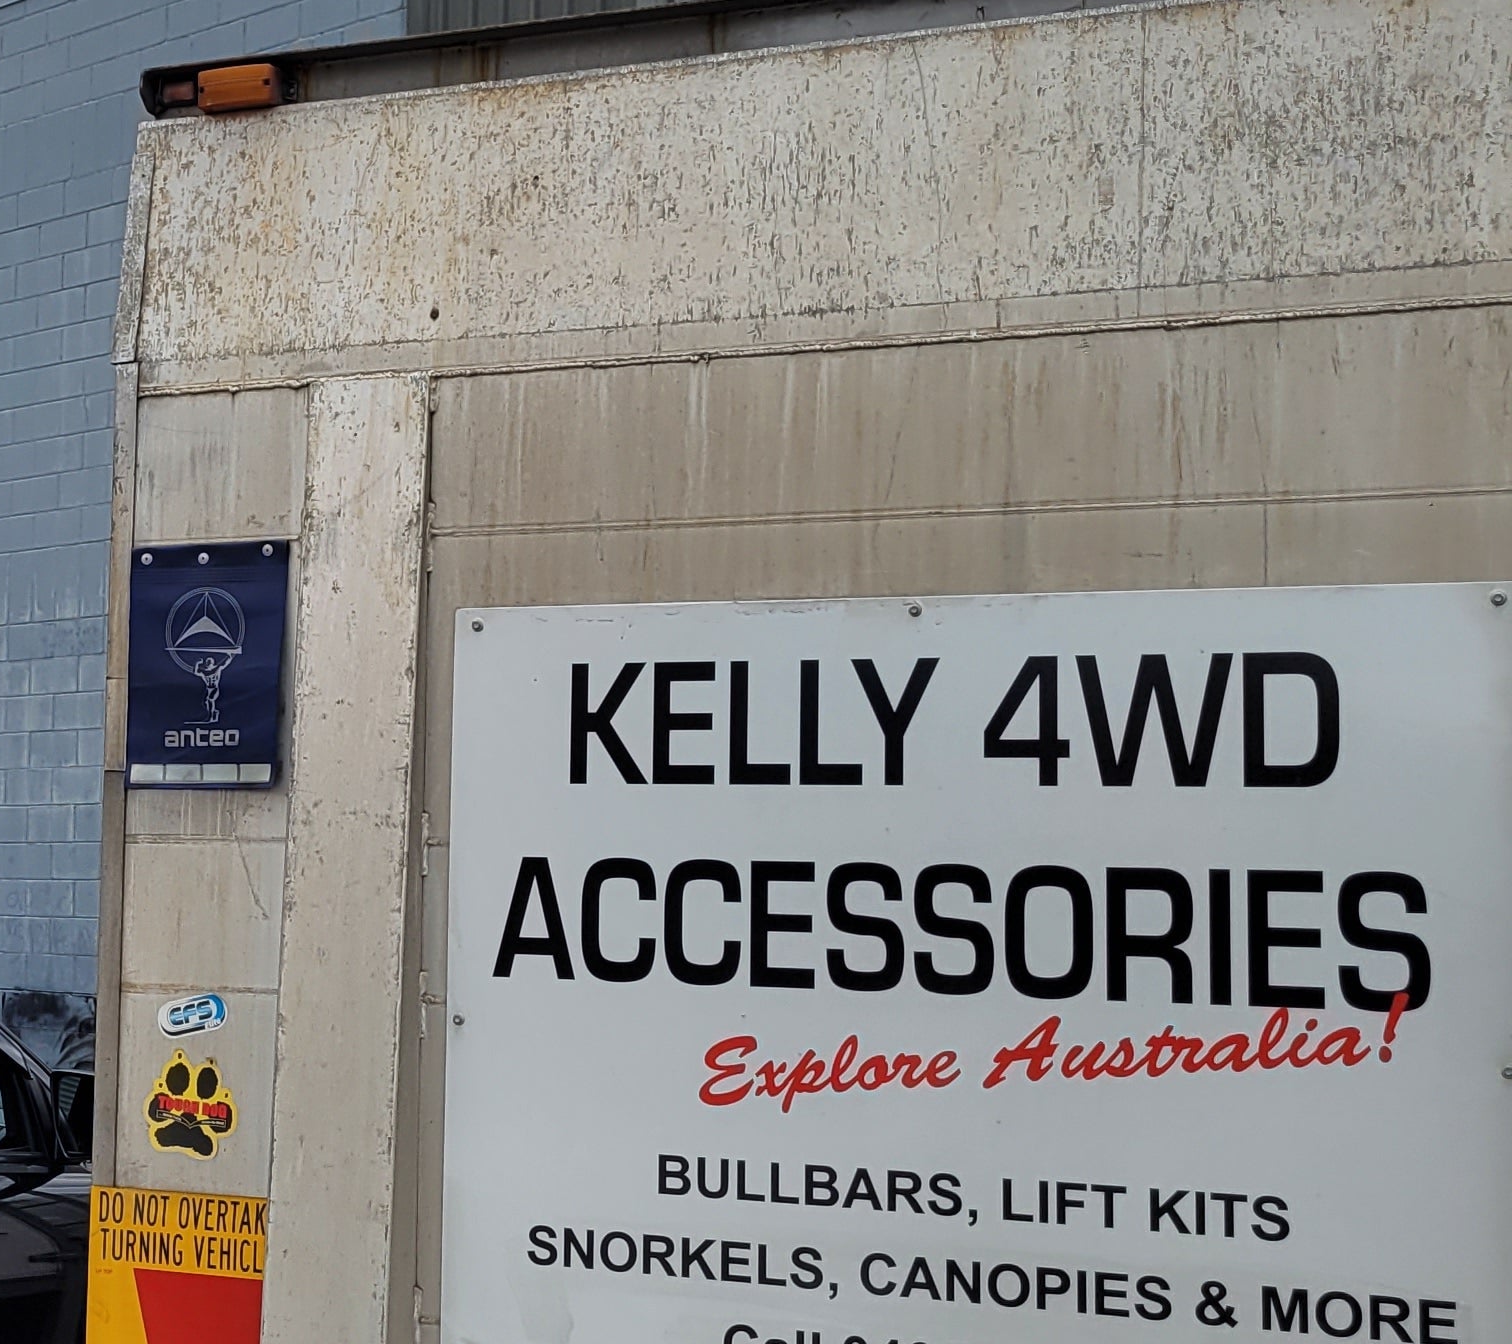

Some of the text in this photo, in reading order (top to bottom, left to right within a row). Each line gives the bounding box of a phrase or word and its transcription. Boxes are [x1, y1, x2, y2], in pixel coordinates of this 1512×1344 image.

[163, 727, 240, 748] anteo
[568, 650, 1341, 789] KELLY 4WD
[492, 855, 1433, 1012] ACCESSORIES
[168, 999, 213, 1026] EFS
[698, 991, 1410, 1114] Explore Australia!
[98, 1190, 125, 1224] DO
[133, 1192, 170, 1228] NOT
[656, 1152, 1291, 1243] BULLBARS, LIFT KITS
[99, 1227, 184, 1267] TURNING
[526, 1224, 840, 1302] SNORKELS,
[859, 1251, 1174, 1325] CANOPIES
[1194, 1279, 1240, 1328] &
